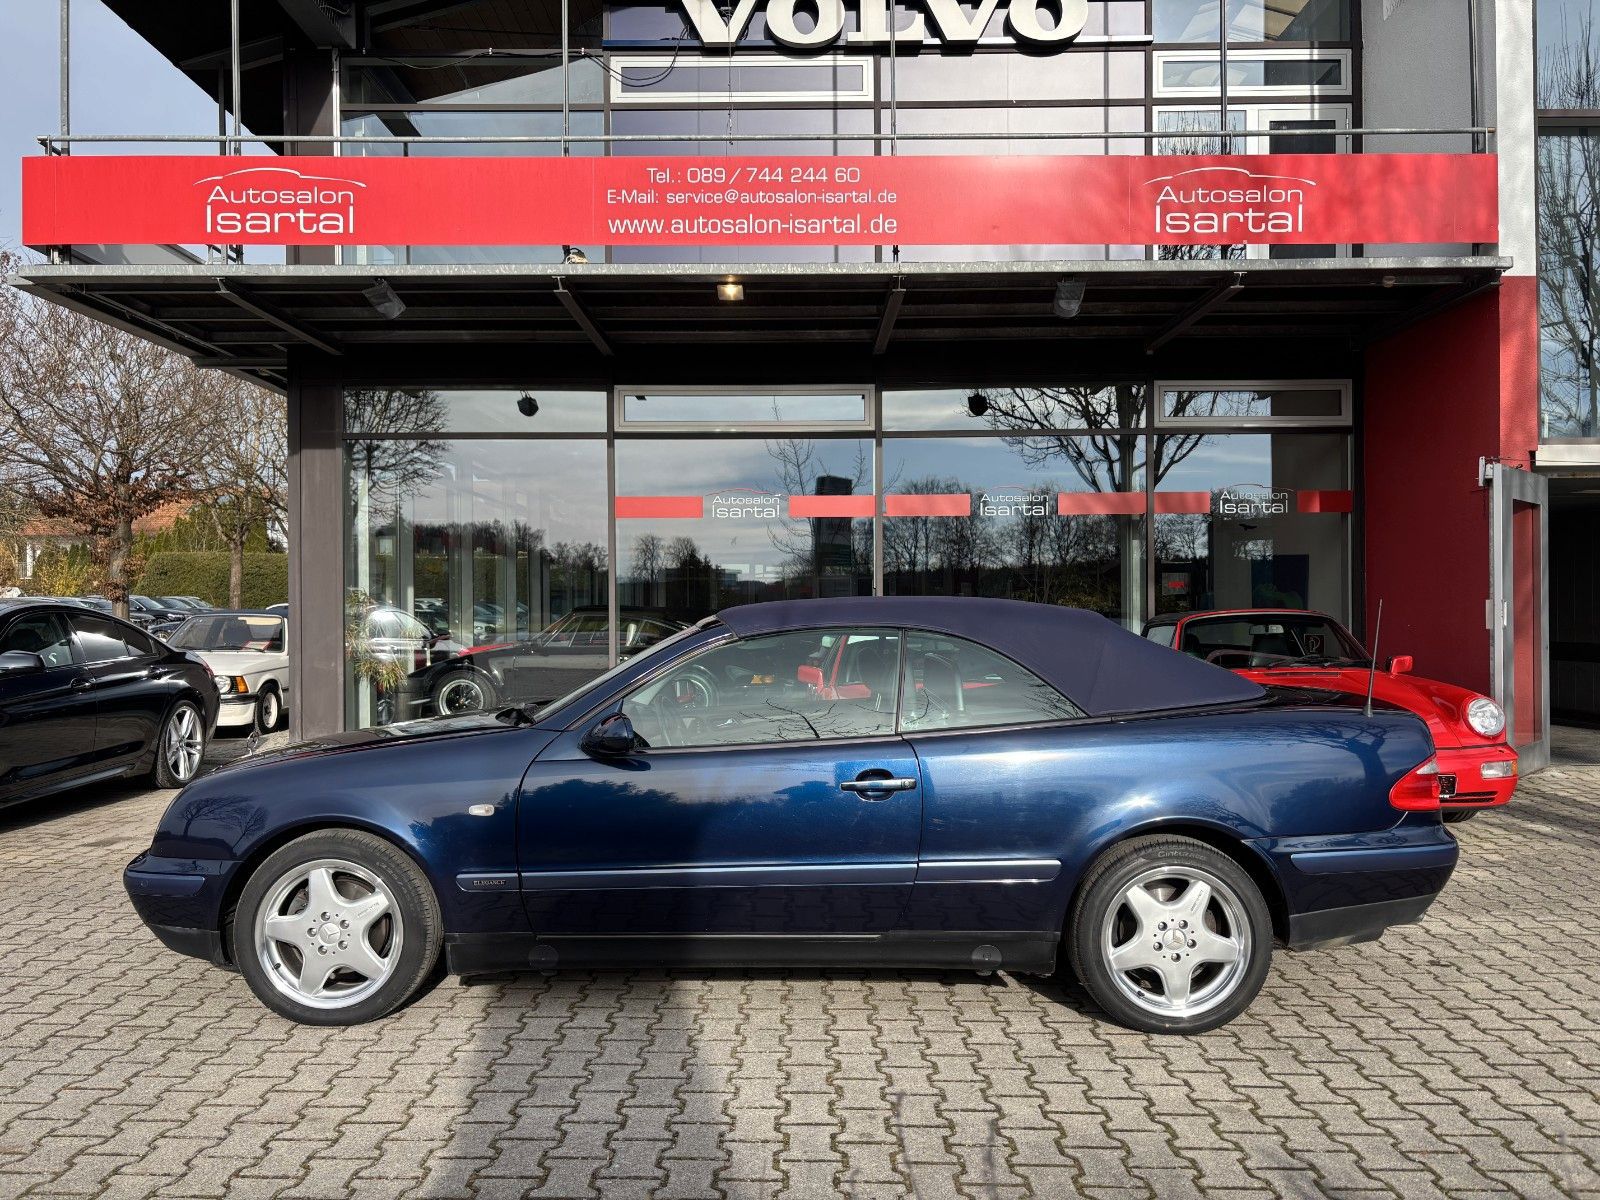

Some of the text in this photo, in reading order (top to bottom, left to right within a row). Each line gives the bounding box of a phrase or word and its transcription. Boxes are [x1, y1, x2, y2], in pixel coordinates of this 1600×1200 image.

[678, 0, 1089, 48] VOLVO
[647, 167, 860, 184] Tel.: 089 / 744 244 60
[207, 185, 354, 204] Autosalon
[607, 189, 897, 204] E-Mail: service@autosalon-isartal.de
[1156, 185, 1304, 203] Autosalon
[206, 204, 354, 234] Isartal
[608, 213, 897, 234] www.autosalon-isartal.de
[1155, 204, 1304, 234] Isartal
[712, 495, 780, 505] Autosalon
[980, 493, 1049, 502] Autosalon
[1220, 491, 1288, 500] Autosalon
[711, 504, 780, 518] Isartal
[980, 502, 1049, 516] Isartal
[1220, 500, 1288, 514] Isartal
